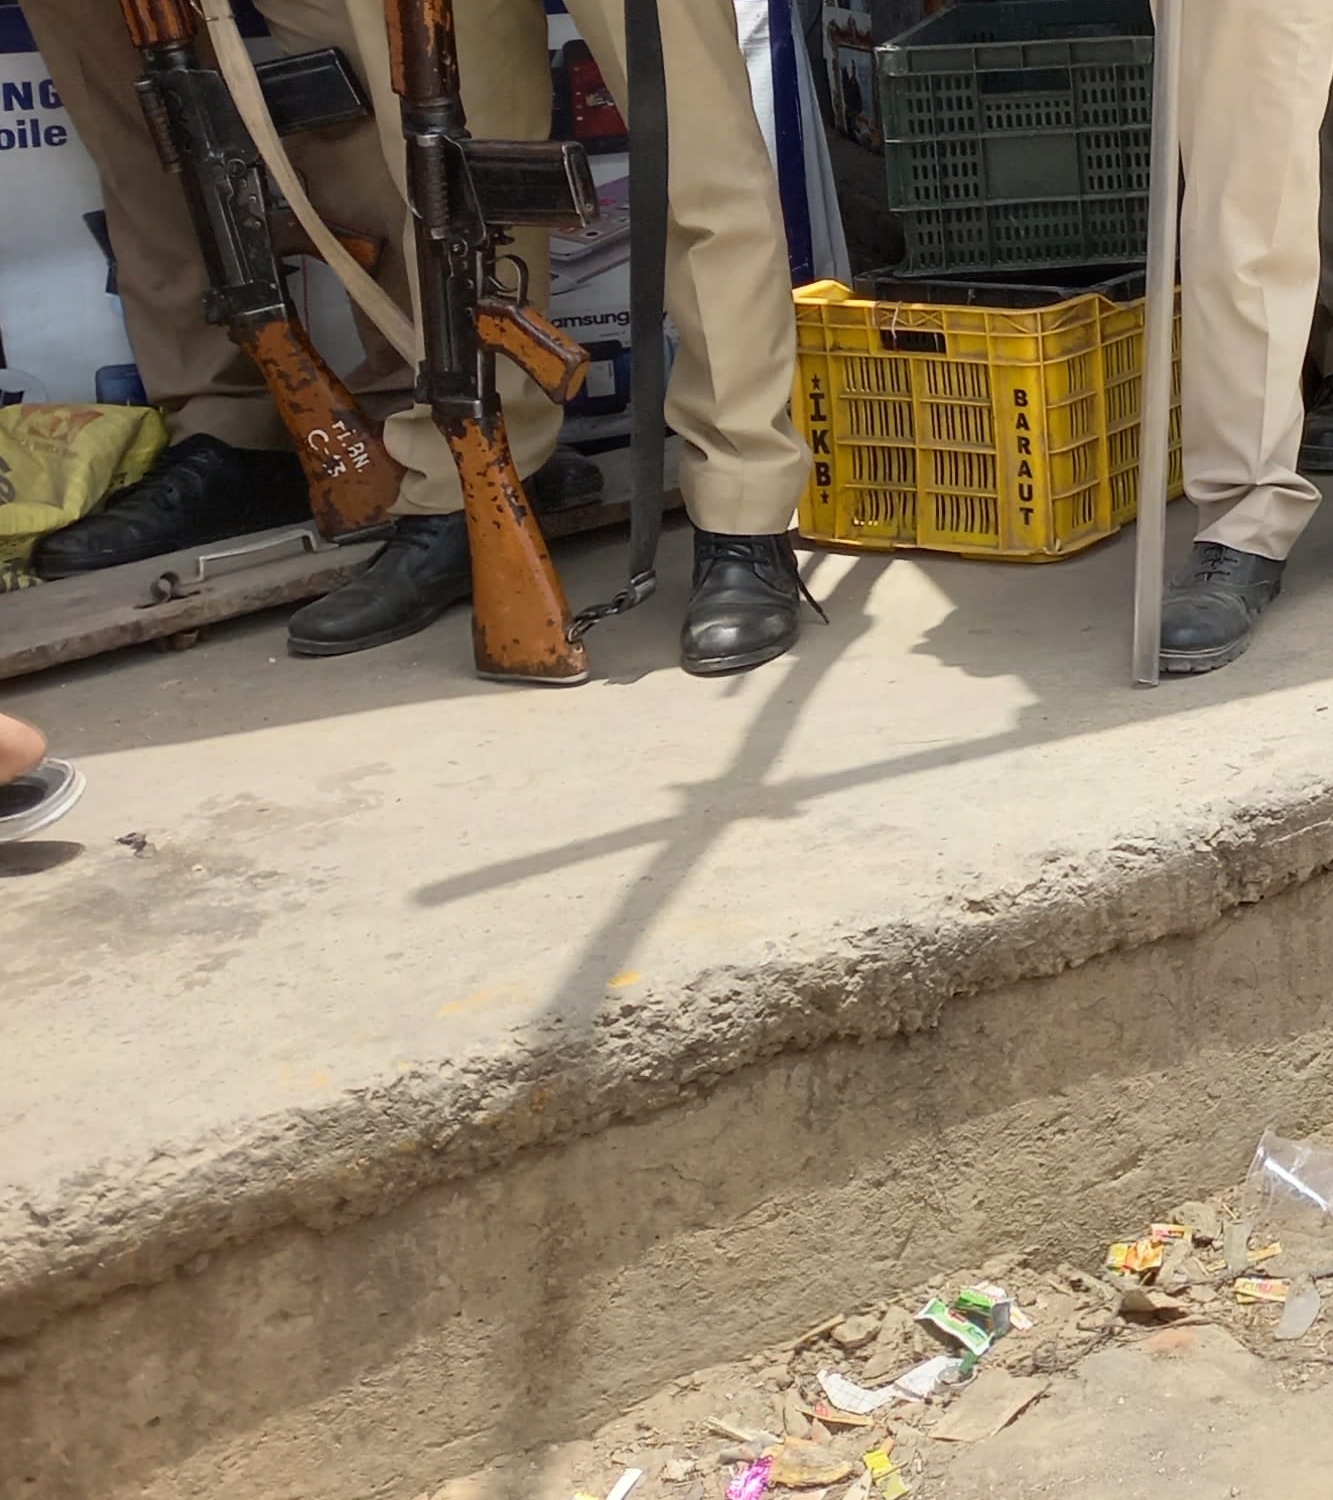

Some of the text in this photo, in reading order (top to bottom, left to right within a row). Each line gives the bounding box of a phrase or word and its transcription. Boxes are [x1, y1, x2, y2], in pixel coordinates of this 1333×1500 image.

[549, 310, 630, 329] amsung
[808, 392, 832, 487] IKB
[1013, 388, 1035, 526] BARAUT
